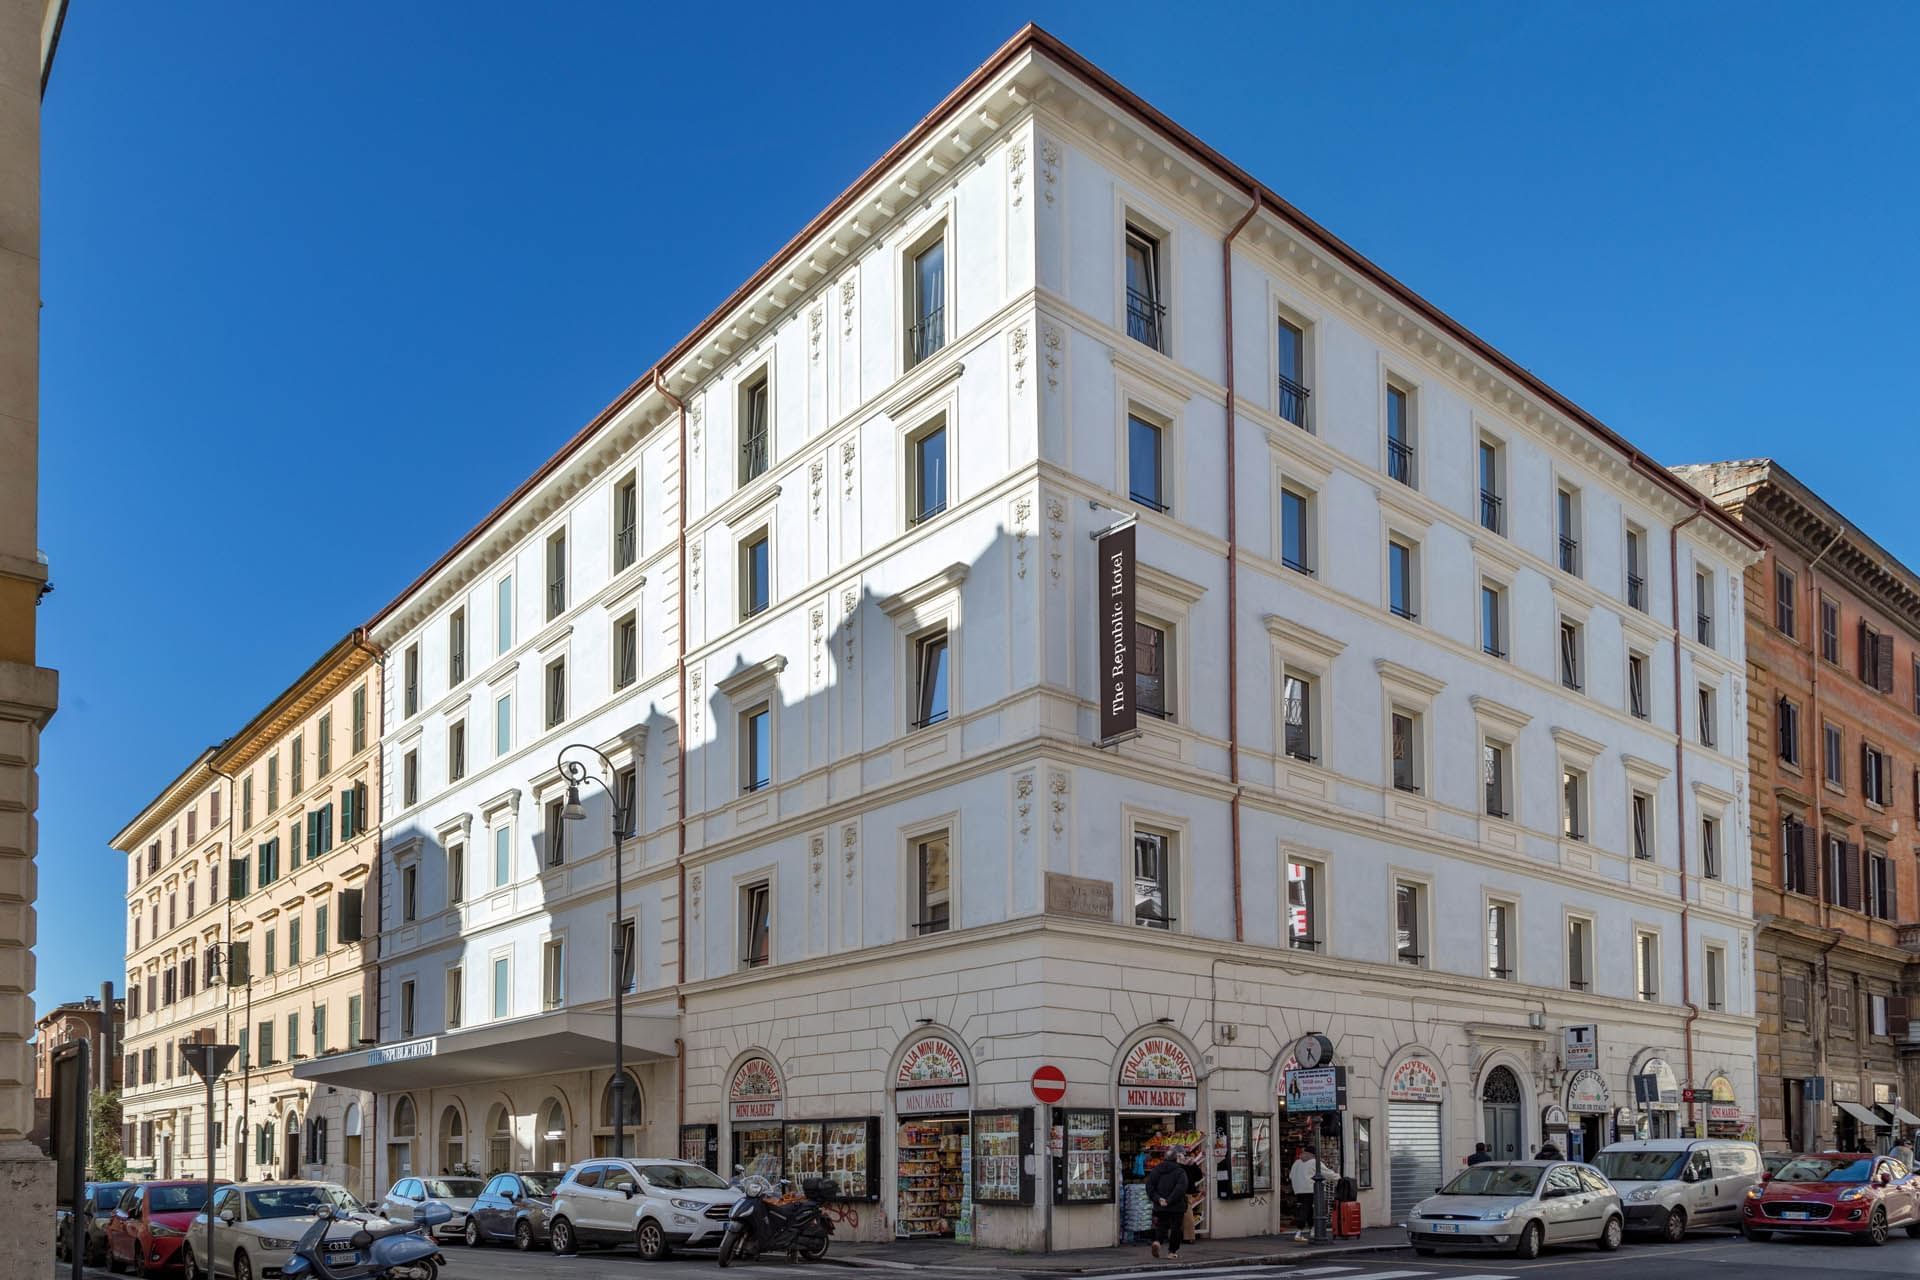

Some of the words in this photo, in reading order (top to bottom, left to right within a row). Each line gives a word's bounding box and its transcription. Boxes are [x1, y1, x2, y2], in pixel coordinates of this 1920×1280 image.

[1111, 550, 1123, 598] Hotel
[1112, 601, 1126, 678] Republic
[1113, 682, 1124, 716] The
[1570, 1027, 1588, 1042] T
[382, 1045, 412, 1063] REPUBLIC
[412, 1041, 433, 1057] HOTEL
[899, 1050, 920, 1082] ITALIA
[917, 1041, 935, 1058] MINI
[935, 1041, 964, 1078] MARKET
[1124, 1047, 1147, 1079] ITALIA
[1144, 1040, 1164, 1056] MINI
[1164, 1042, 1194, 1082] MARKET
[731, 1069, 748, 1097] ITALIA
[746, 1061, 759, 1073] MINI
[760, 1061, 780, 1093] MARKET
[1394, 1060, 1437, 1084] SOUVENIR
[1570, 1070, 1609, 1101] BORSETTERIA
[736, 1104, 749, 1118] MINI
[750, 1103, 775, 1117] MARKET
[906, 1095, 923, 1110] MINI
[925, 1092, 954, 1109] MARKET
[1128, 1090, 1148, 1105] MINI
[1150, 1091, 1186, 1107] MARKET
